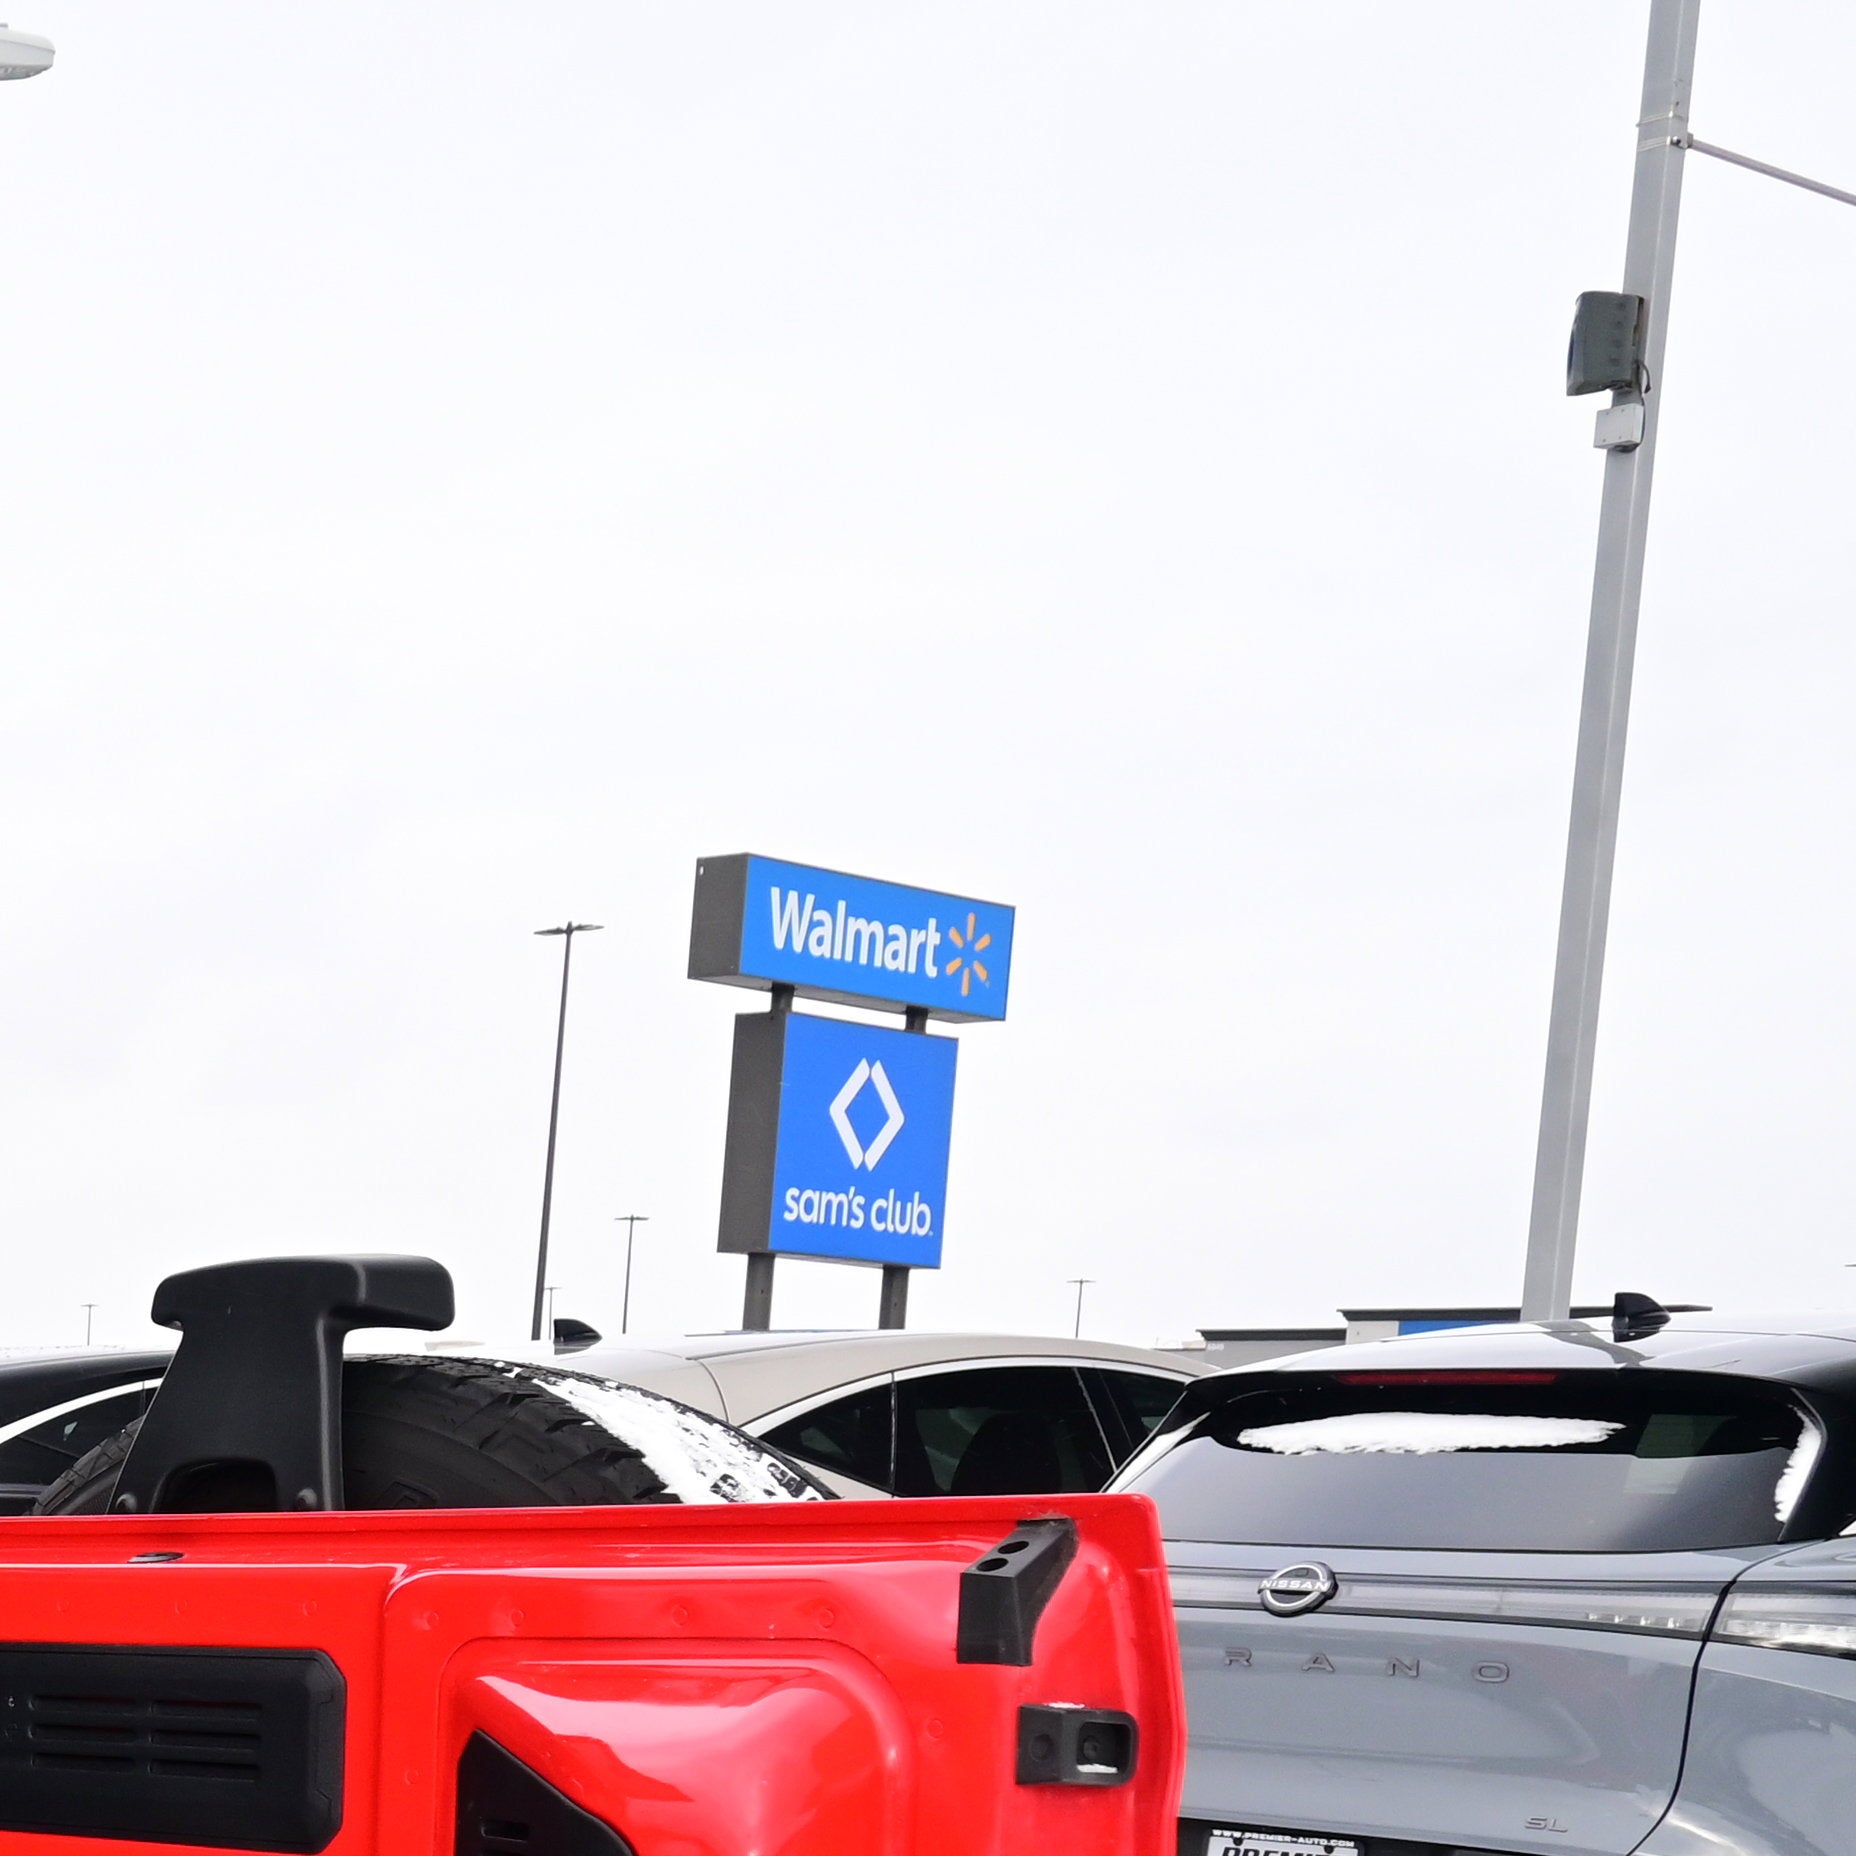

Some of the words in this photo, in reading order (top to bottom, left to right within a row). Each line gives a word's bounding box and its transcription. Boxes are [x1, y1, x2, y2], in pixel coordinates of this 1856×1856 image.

[770, 886, 941, 978] Walmart
[783, 1186, 866, 1229] sam's
[1260, 1580, 1329, 1592] NISSAN
[1524, 1816, 1568, 1833] SL
